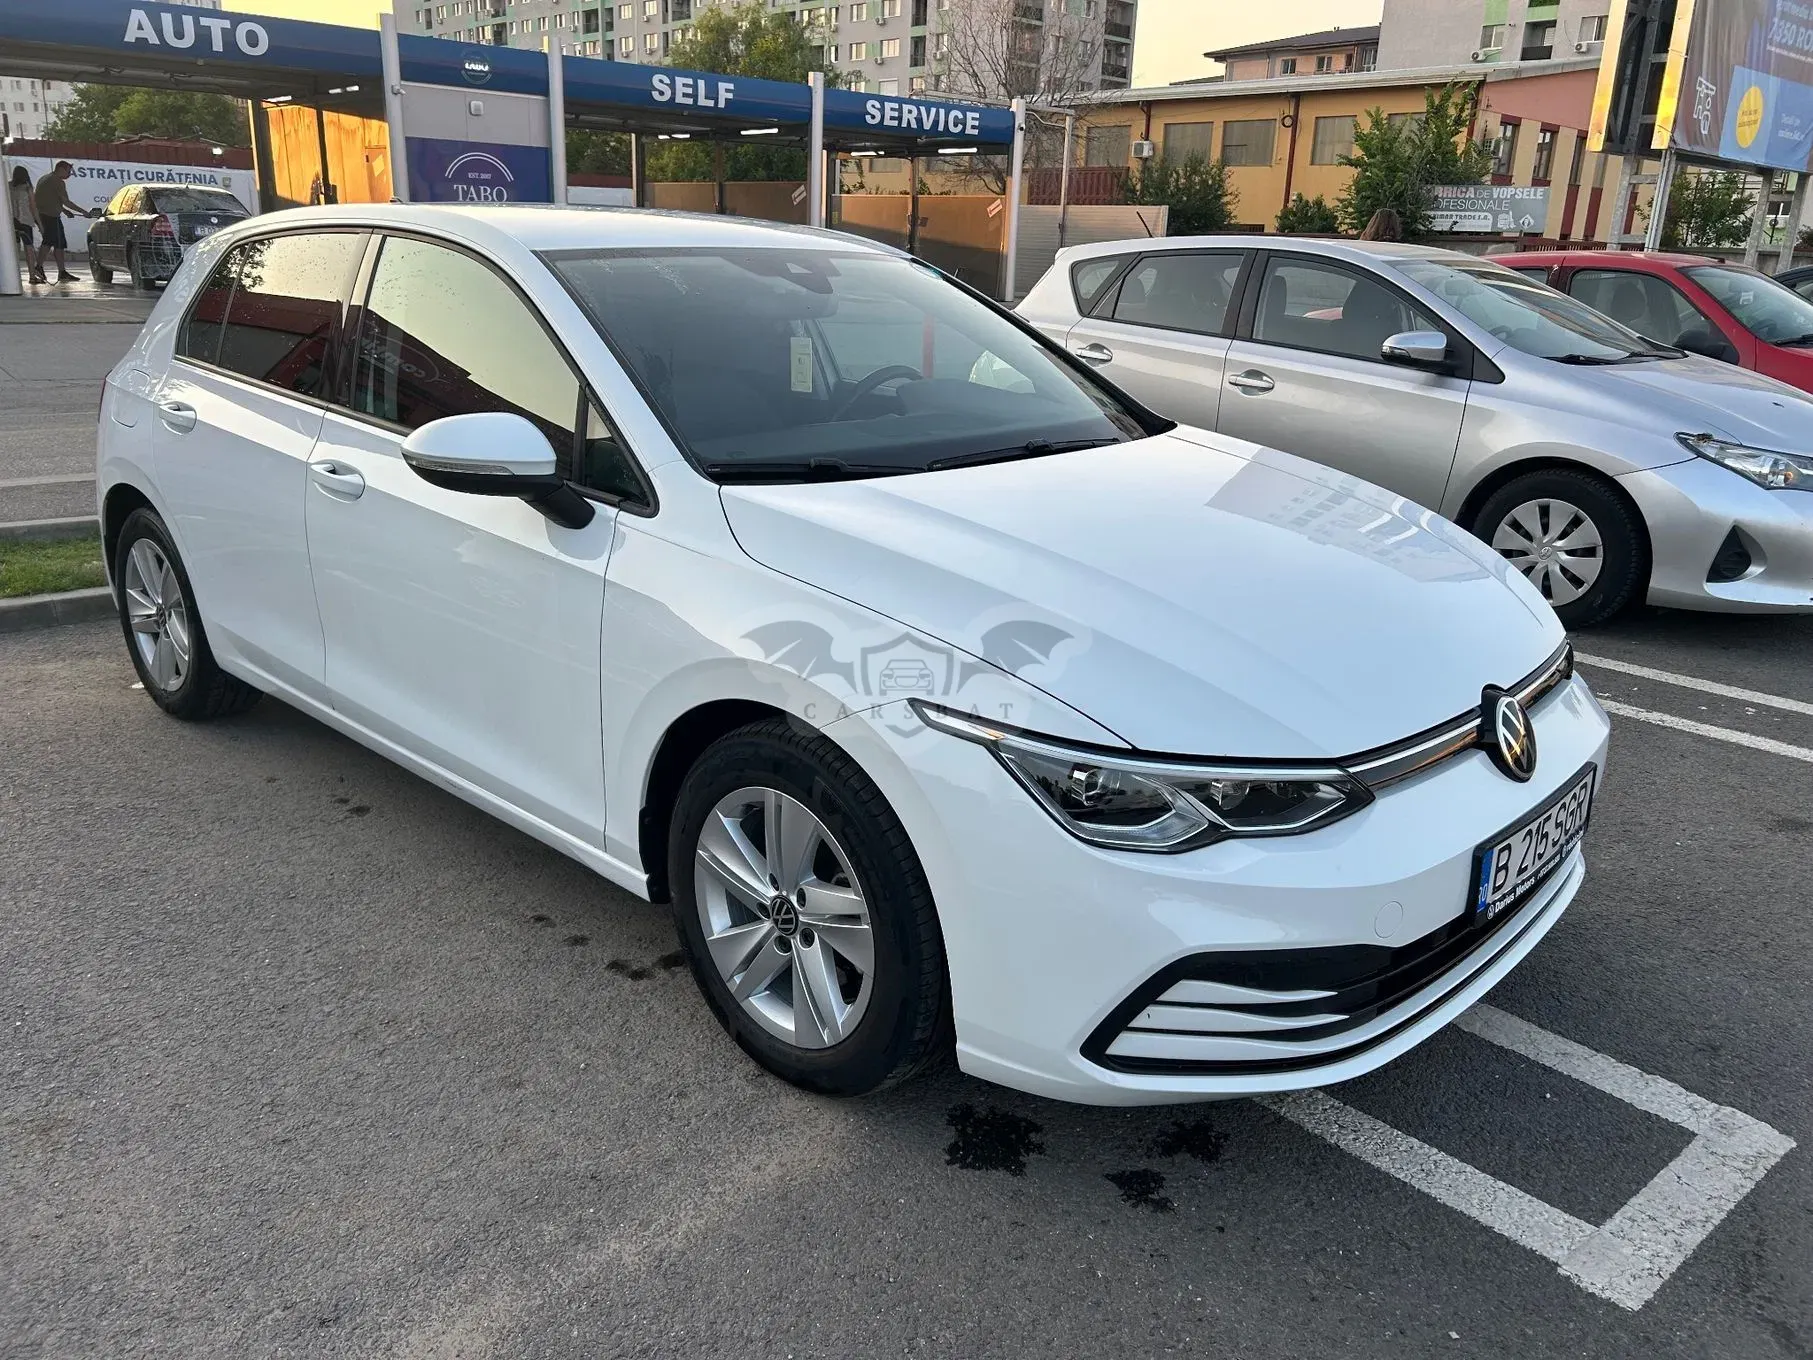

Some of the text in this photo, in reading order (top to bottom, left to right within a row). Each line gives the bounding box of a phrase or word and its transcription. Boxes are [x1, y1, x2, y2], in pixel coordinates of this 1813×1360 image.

[124, 8, 269, 56] AUTO
[651, 73, 734, 109] SELF
[865, 99, 980, 135] SERVICE
[453, 184, 508, 202] TABO
[1476, 190, 1493, 199] DE
[1492, 187, 1544, 200] VOPSELE
[1492, 842, 1512, 895] B
[1516, 812, 1552, 878] 215
[1552, 781, 1588, 846] SGR
[1495, 876, 1535, 913] Darius Motors
